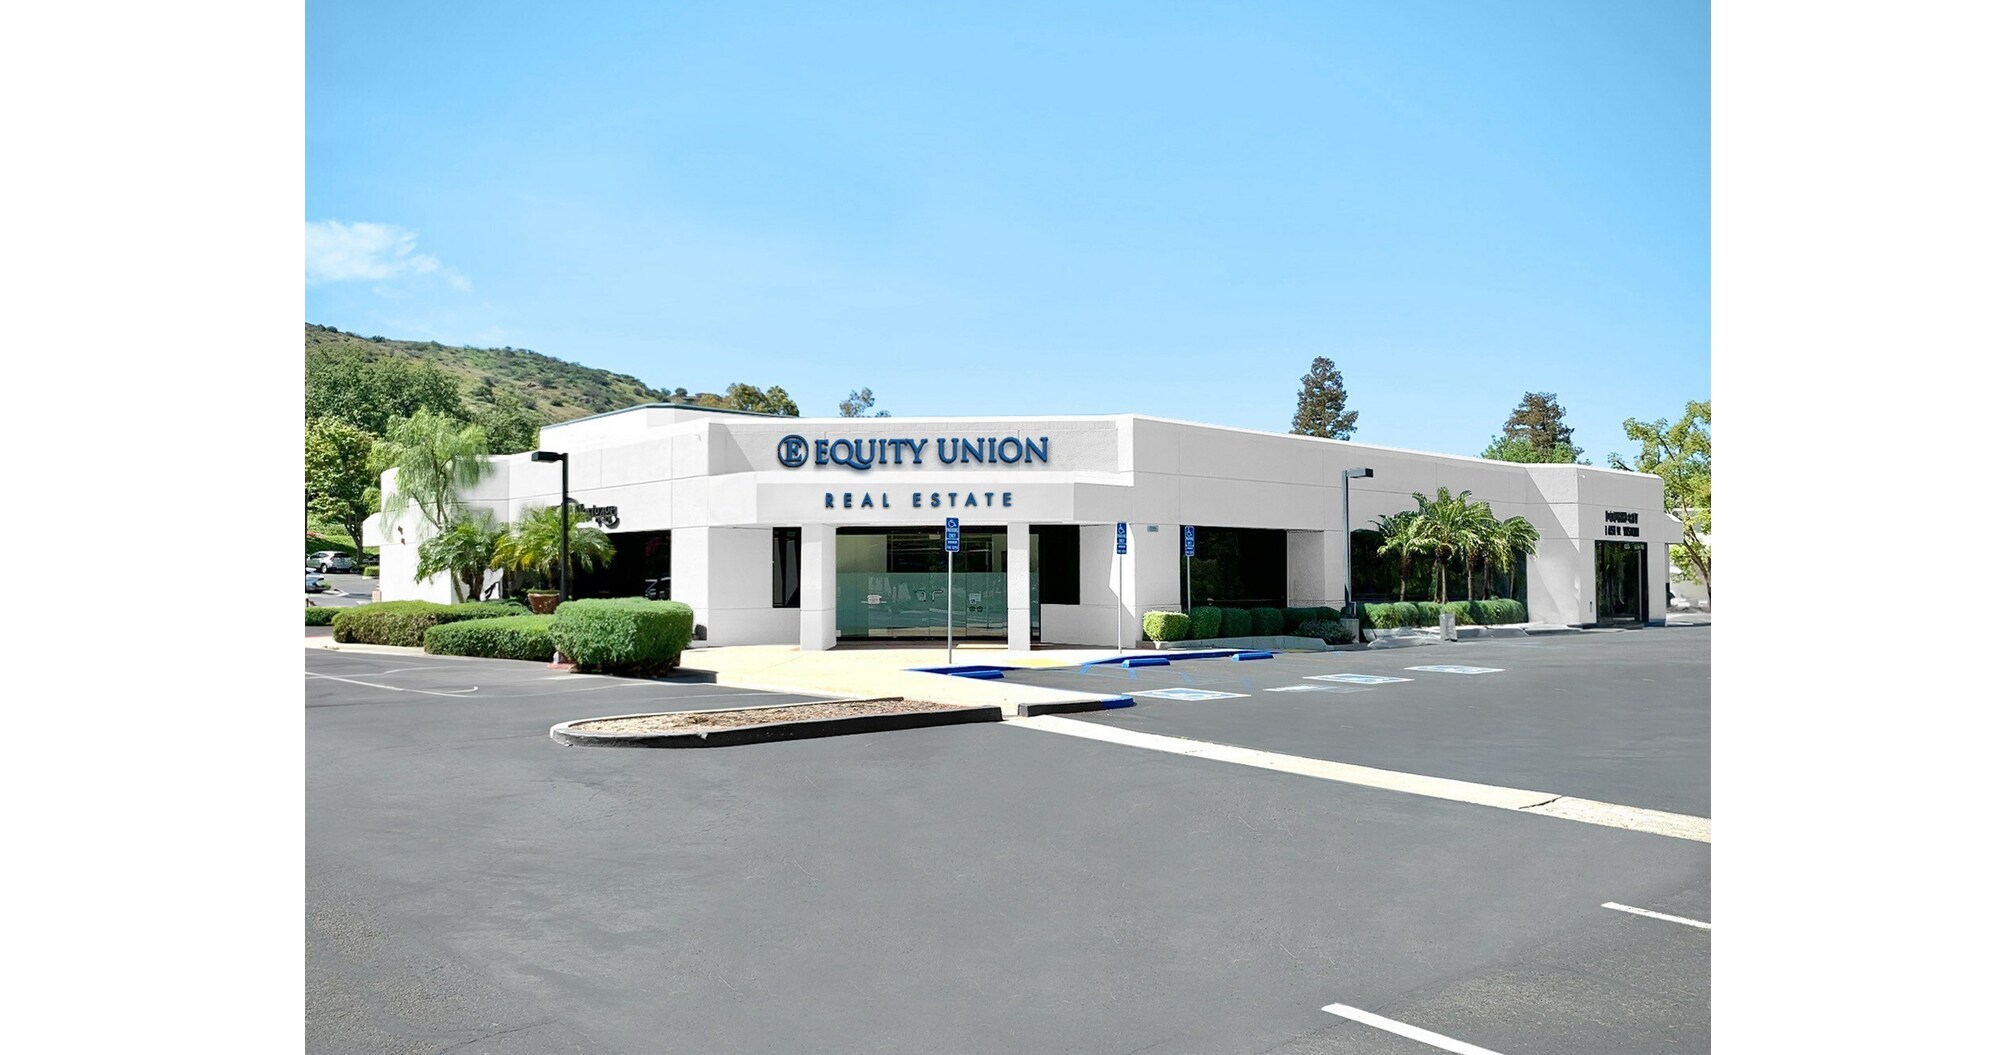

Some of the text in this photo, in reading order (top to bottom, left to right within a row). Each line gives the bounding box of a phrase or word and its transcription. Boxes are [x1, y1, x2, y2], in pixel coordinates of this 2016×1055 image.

[814, 437, 928, 470] EQUITY
[937, 436, 1050, 465] UNION
[825, 492, 1013, 508] REAL ESTATE
